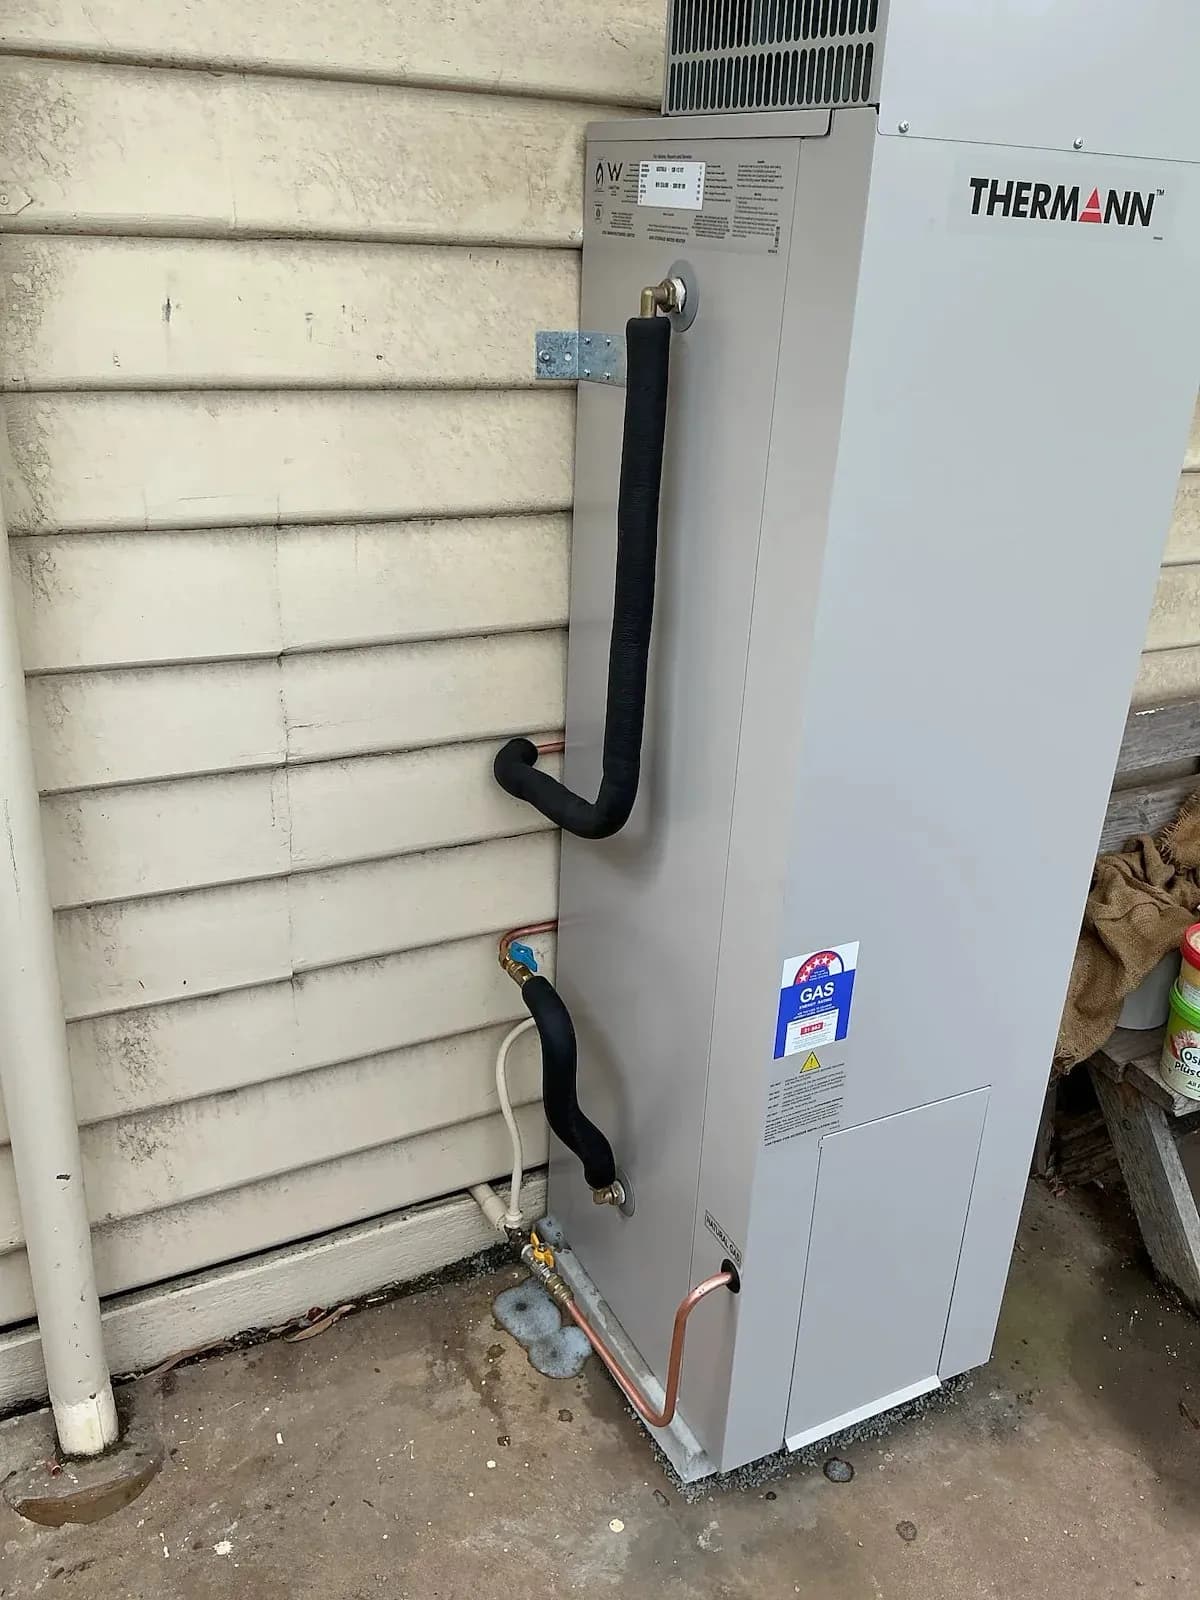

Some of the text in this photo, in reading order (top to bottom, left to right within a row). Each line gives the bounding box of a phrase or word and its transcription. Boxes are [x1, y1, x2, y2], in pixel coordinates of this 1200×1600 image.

[969, 177, 1155, 227] THERMANN
[800, 981, 835, 1003] GAS
[1184, 1051, 1200, 1066] Os
[705, 1215, 740, 1262] NATURAL GAS
